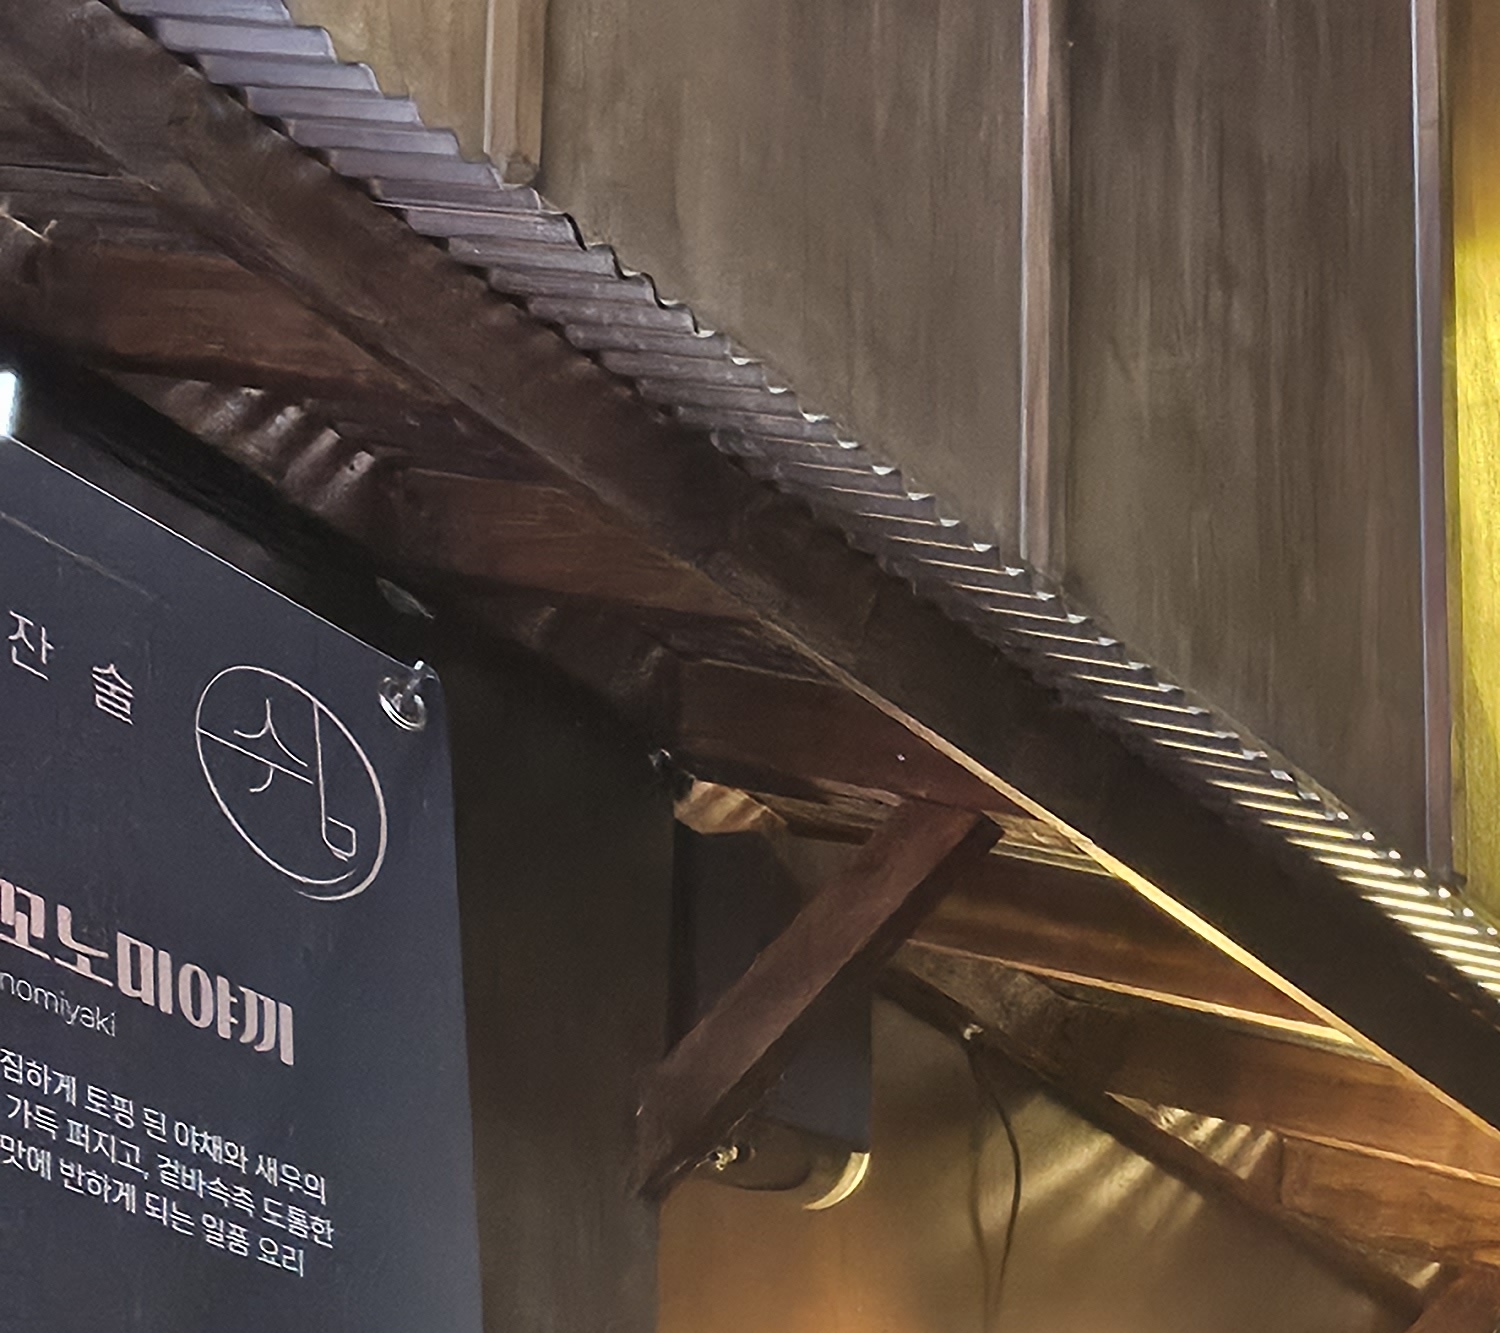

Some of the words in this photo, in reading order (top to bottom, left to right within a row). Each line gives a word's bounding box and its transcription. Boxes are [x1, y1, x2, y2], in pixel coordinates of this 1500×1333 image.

[8, 610, 54, 681] 잔
[91, 663, 134, 725] 술
[0, 972, 116, 1037] nomiyaki
[6, 1094, 59, 1140] 가득
[66, 1118, 149, 1180] 퍼지고,
[157, 1154, 256, 1217] 겉바속촉
[262, 1197, 334, 1248] 도톰한
[85, 1084, 134, 1129] 토핑
[143, 1107, 167, 1143] 된
[174, 1121, 248, 1174] 야채와
[256, 1154, 327, 1205] 새우의
[0, 1135, 52, 1180] 맛에
[60, 1158, 136, 1213] 반하게
[145, 1192, 195, 1236] 되는
[202, 1213, 250, 1257] 일품
[257, 1237, 304, 1277] 요리
